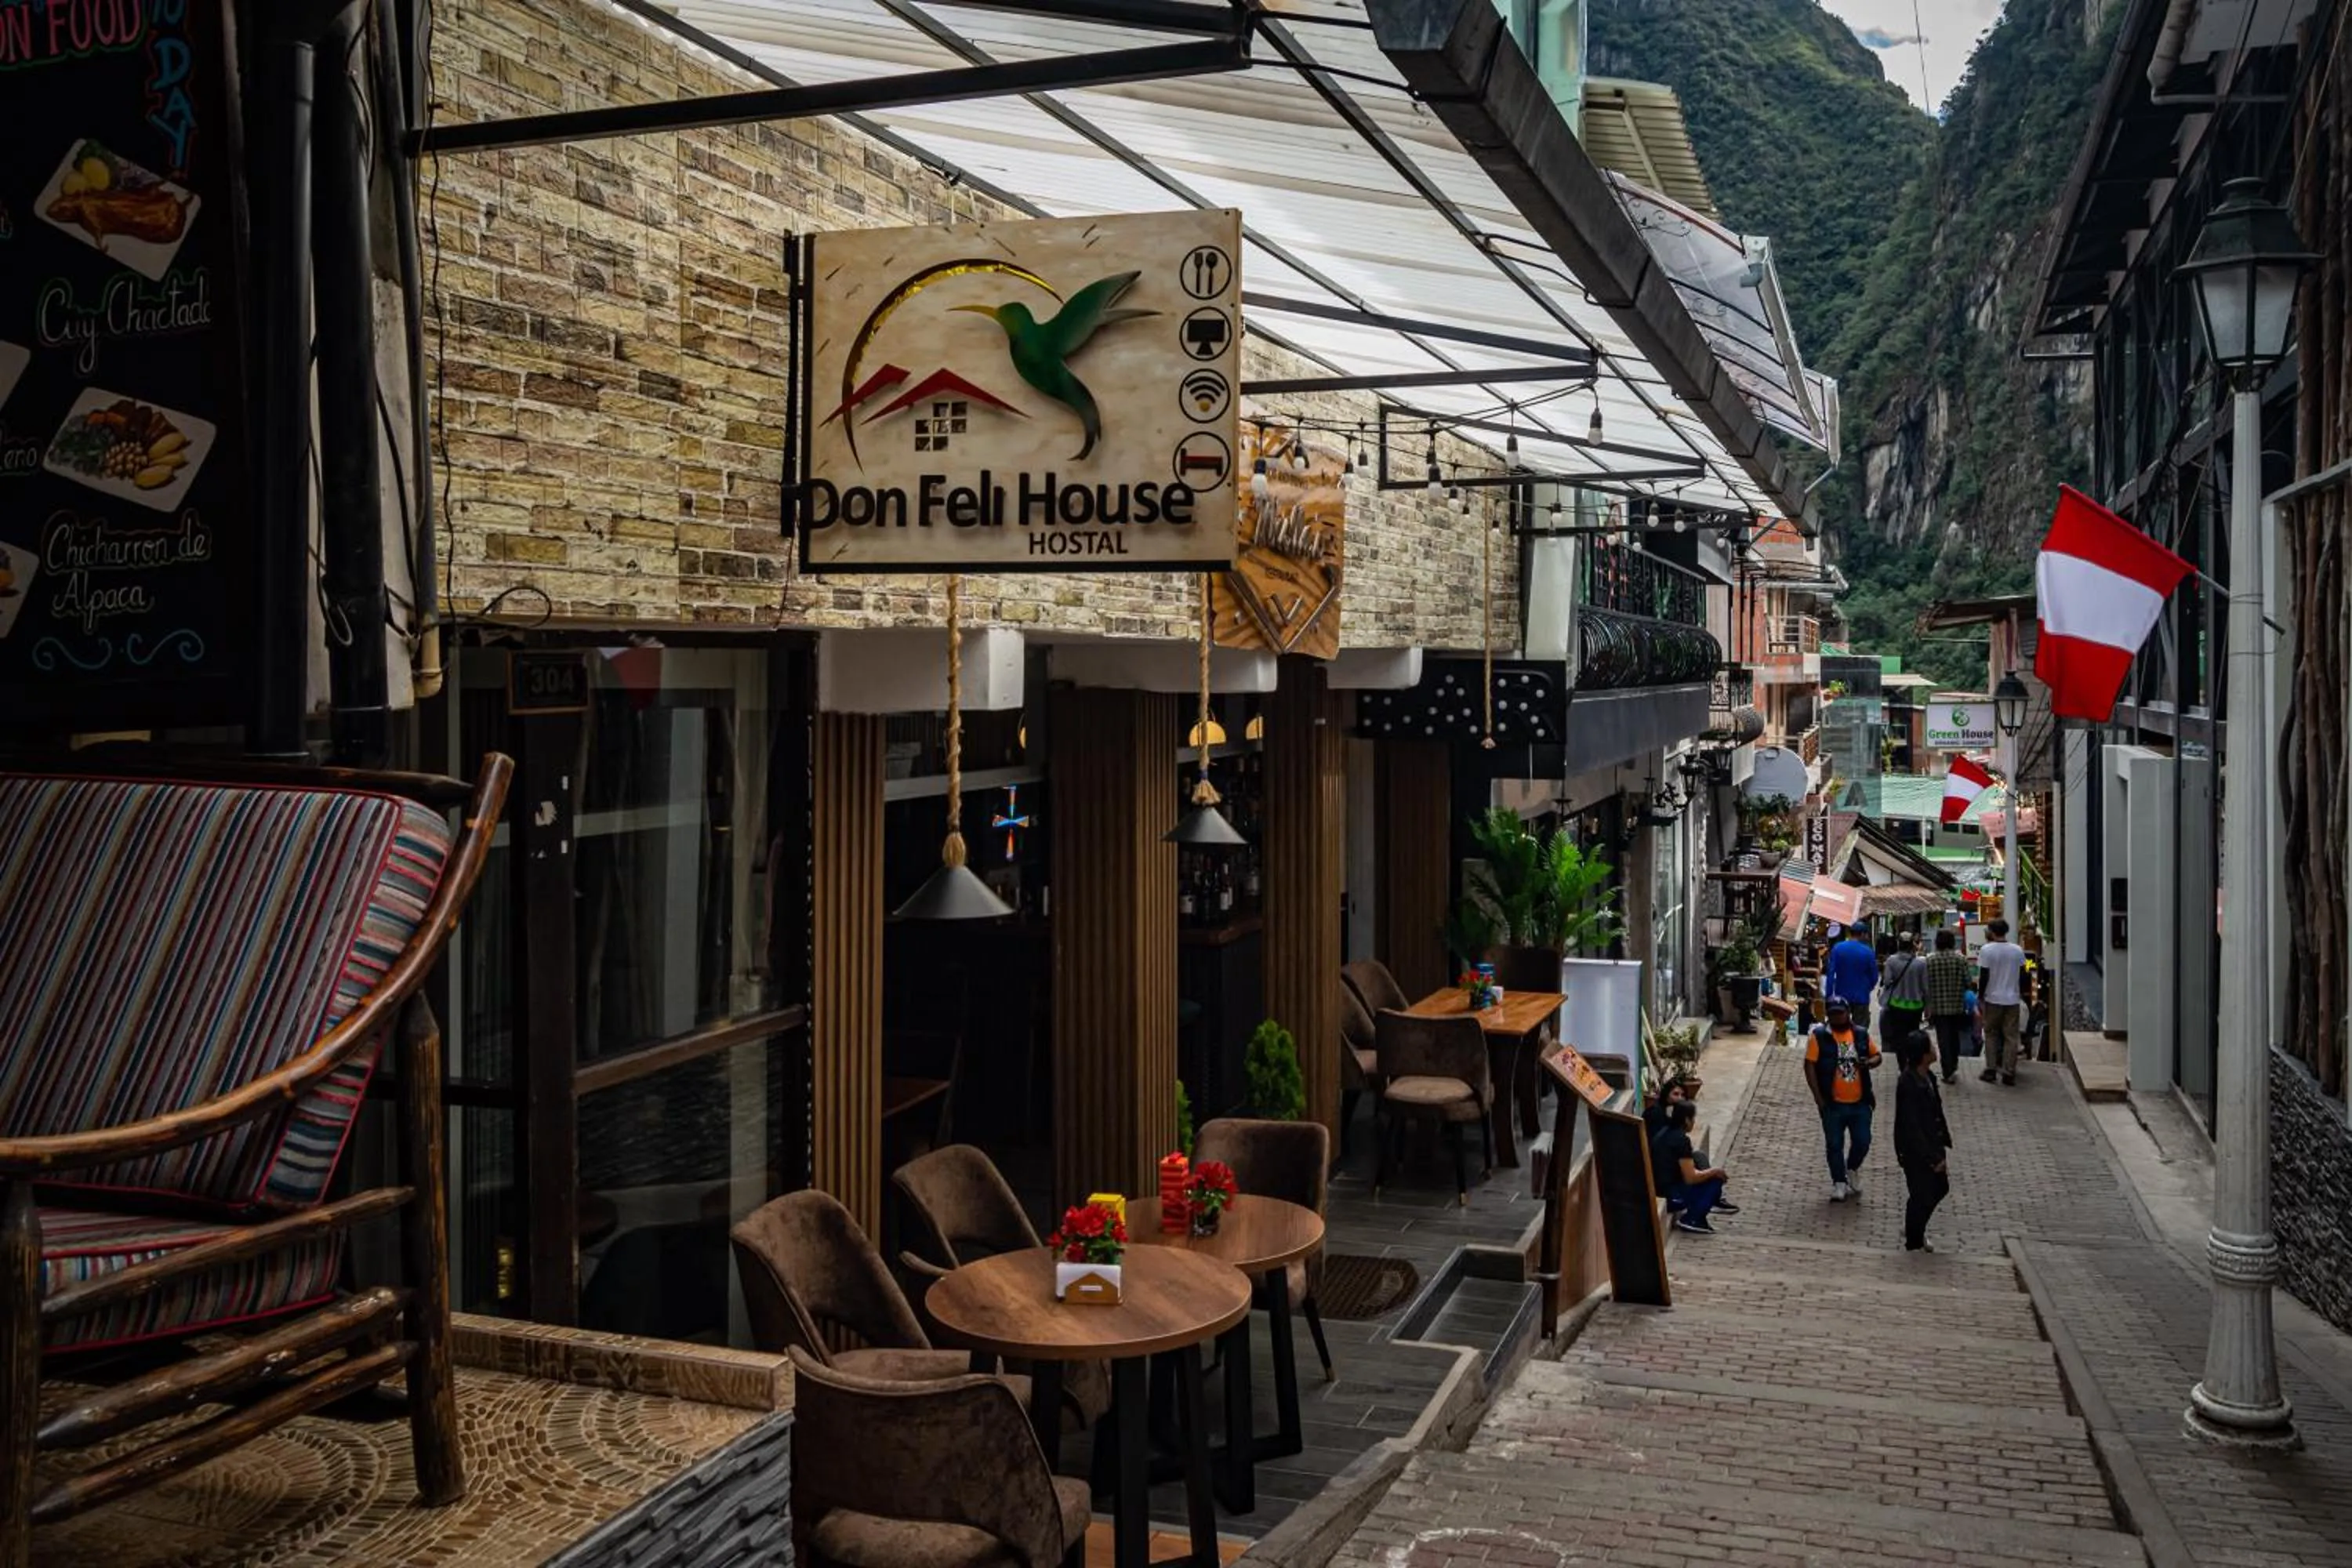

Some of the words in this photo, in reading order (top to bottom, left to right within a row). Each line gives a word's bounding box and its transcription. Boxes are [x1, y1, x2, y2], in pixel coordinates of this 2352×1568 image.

[49, 0, 141, 56] FOOD
[41, 286, 99, 372] Cuy
[804, 476, 907, 529] Don
[918, 470, 1004, 528] Feli
[1018, 470, 1194, 528] House
[47, 522, 169, 570] Chicharron
[179, 518, 206, 558] de
[1028, 530, 1128, 556] HOSTAL
[52, 572, 147, 630] Alpaca
[530, 668, 575, 694] 304
[1928, 728, 1960, 739] Green
[1961, 728, 1994, 739] House
